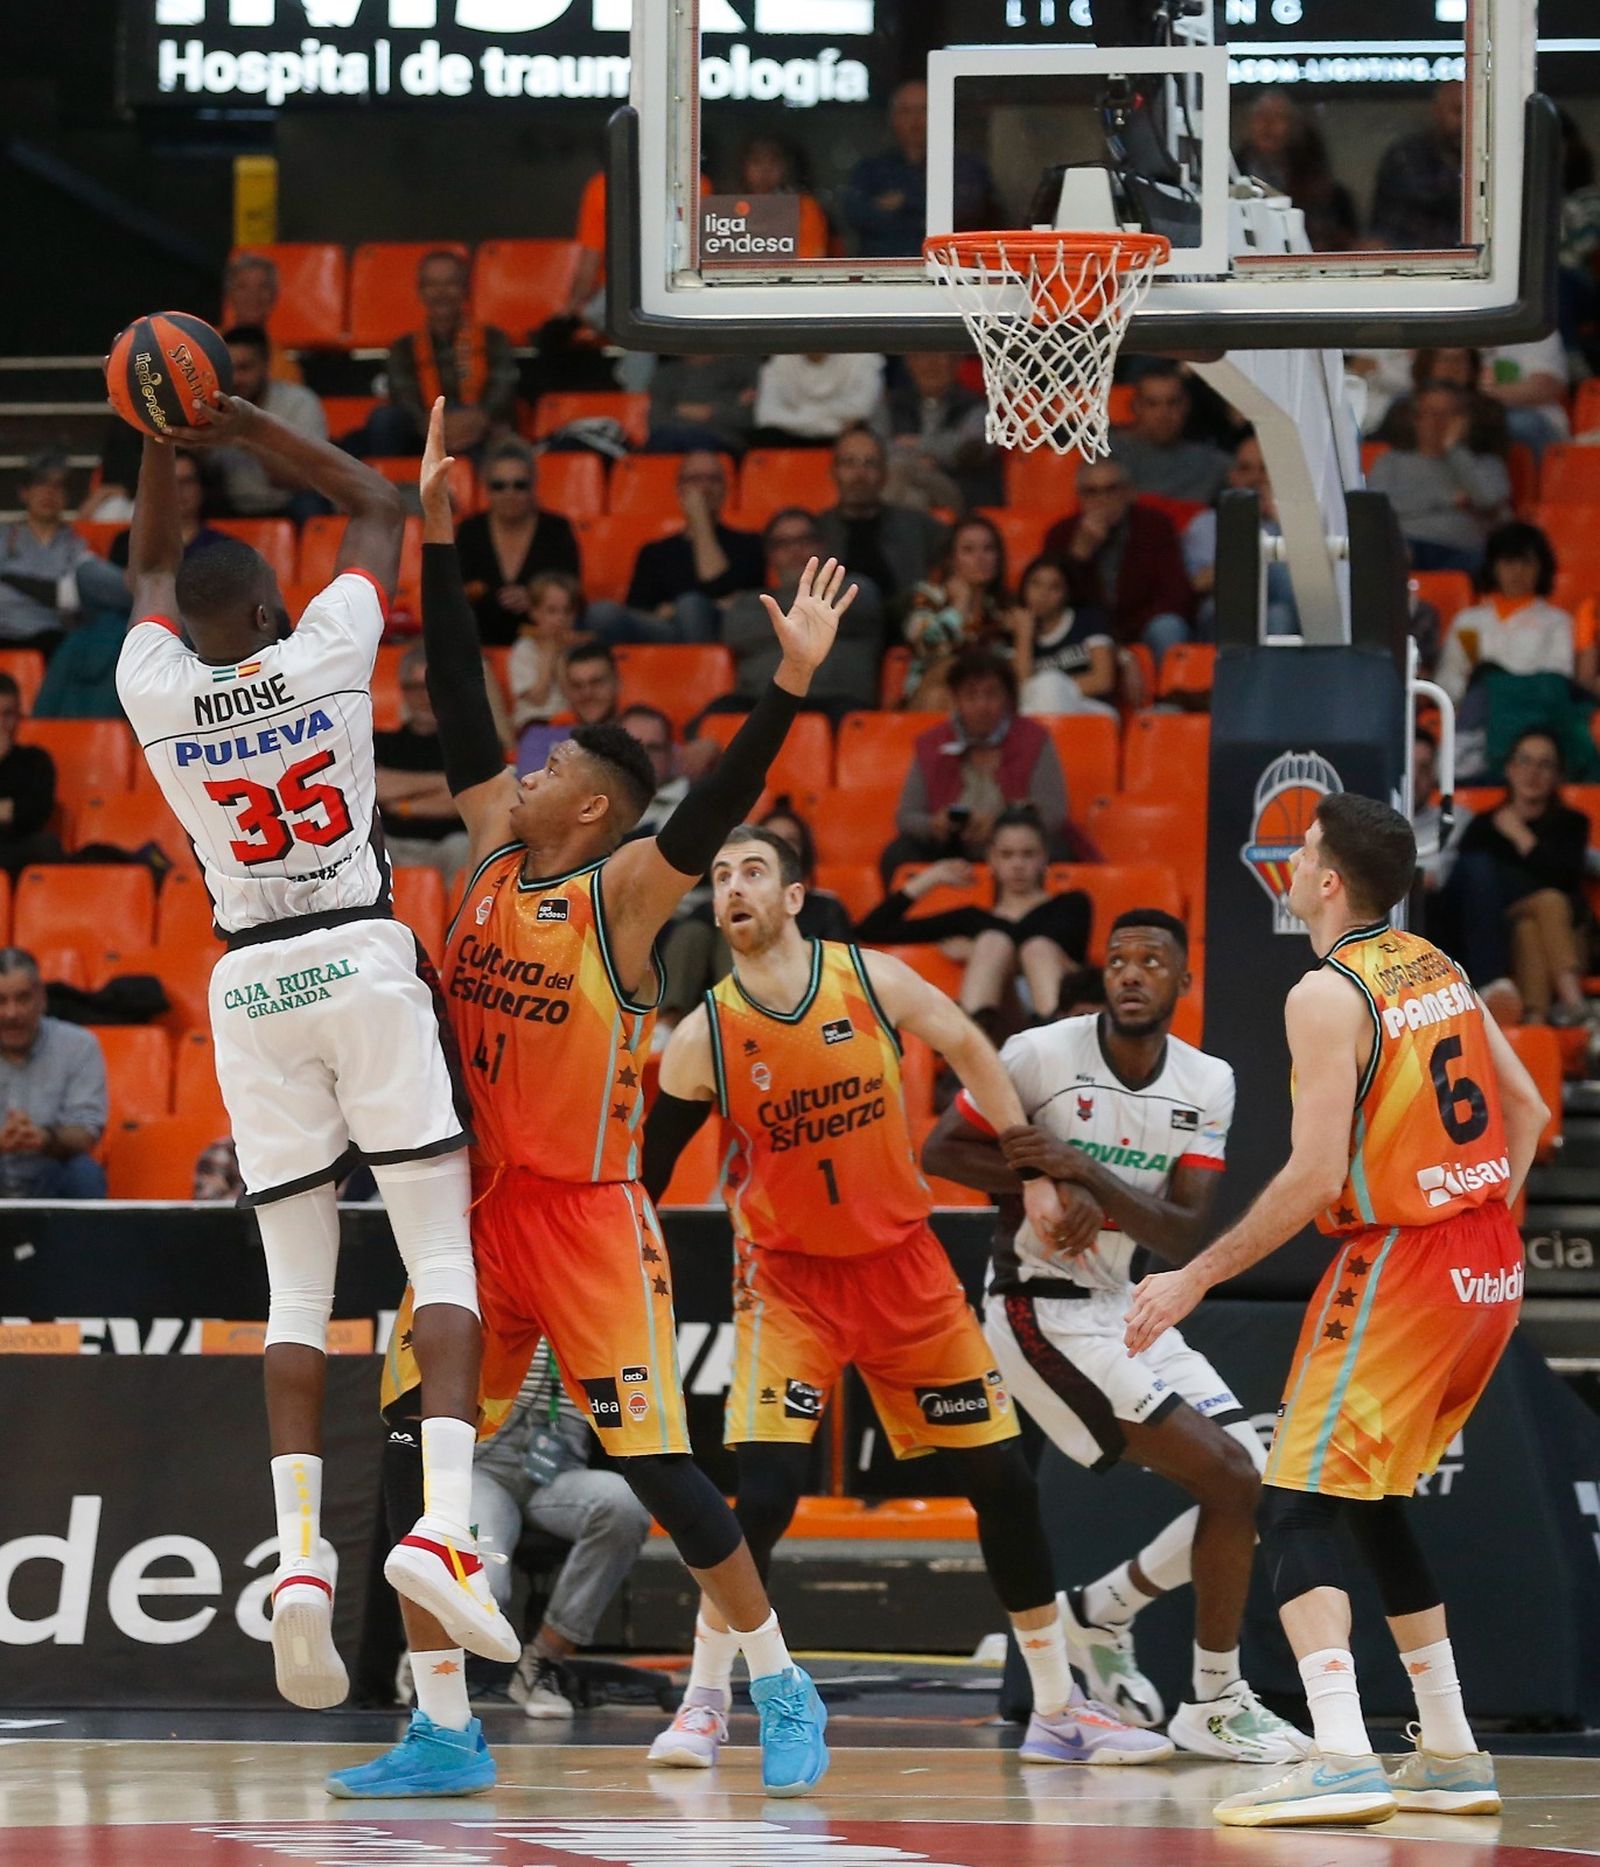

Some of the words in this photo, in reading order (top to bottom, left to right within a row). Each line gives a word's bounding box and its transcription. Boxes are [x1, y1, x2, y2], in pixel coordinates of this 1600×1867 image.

[158, 38, 391, 106] Hospital
[400, 39, 474, 96] de
[480, 44, 869, 108] traumología
[705, 213, 746, 235] liga
[705, 234, 794, 253] endesa
[194, 672, 295, 726] NDOYE
[175, 709, 334, 767] PULEVA
[203, 749, 354, 866] 35
[224, 982, 271, 1010] CAJA
[277, 959, 359, 996] RURAL
[458, 935, 545, 986] Cultura
[544, 973, 575, 991] del
[247, 987, 332, 1019] GRANADA
[449, 967, 571, 1025] Esfuerzo
[471, 1028, 506, 1085] 41
[758, 1077, 861, 1128] Cultura
[1429, 1034, 1489, 1145] 6
[818, 1158, 840, 1206] 1
[1450, 1261, 1524, 1304] Vitaldi
[590, 1399, 620, 1414] dea
[0, 1495, 340, 1646] dea
